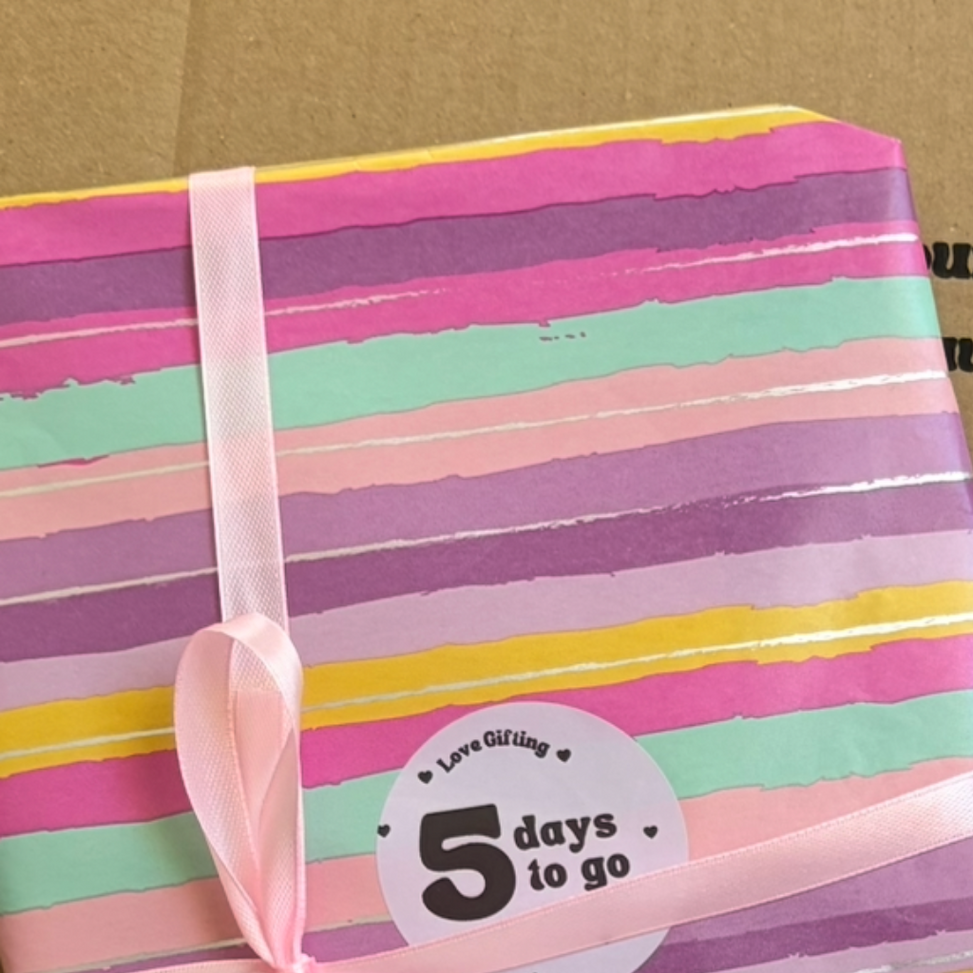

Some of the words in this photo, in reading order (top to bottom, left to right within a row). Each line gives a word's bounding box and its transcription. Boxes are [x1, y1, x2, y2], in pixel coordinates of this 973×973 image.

[436, 739, 483, 773] Love
[483, 729, 550, 759] Gifting
[419, 803, 517, 921] 5
[513, 813, 617, 853] days
[527, 859, 567, 891] to
[581, 853, 630, 891] go
